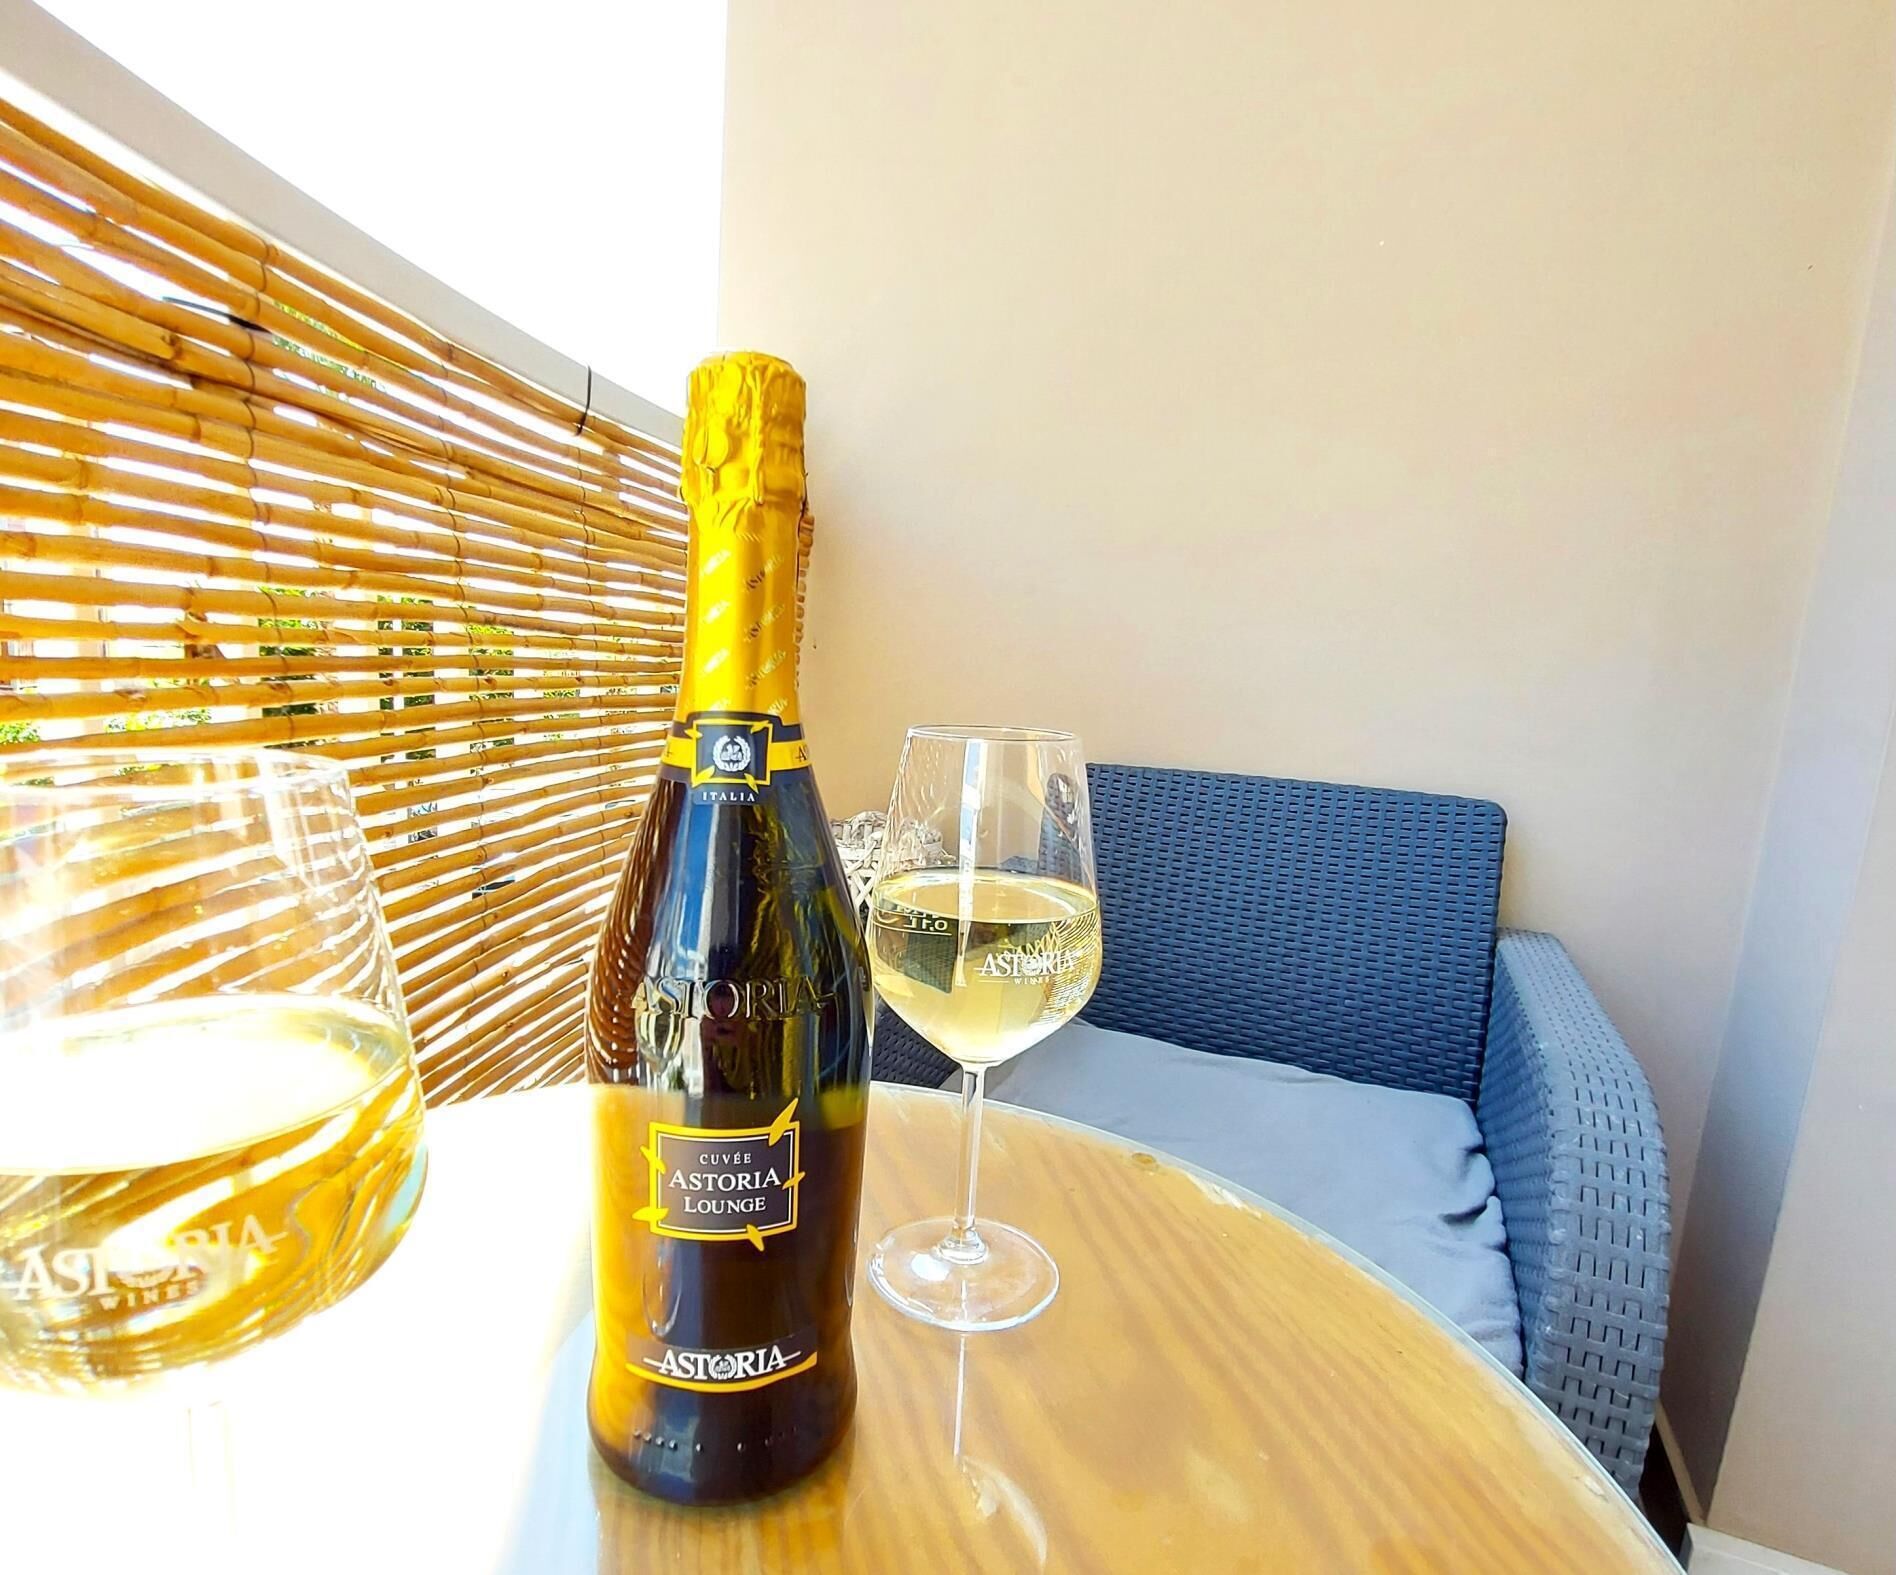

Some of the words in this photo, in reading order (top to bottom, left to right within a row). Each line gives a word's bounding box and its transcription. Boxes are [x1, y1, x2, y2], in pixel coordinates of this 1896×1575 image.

[702, 791, 756, 802] ITALIA
[699, 1151, 752, 1165] CUVÉE
[668, 1167, 782, 1192] ASTORIA
[684, 1196, 767, 1214] LOUNGE
[99, 1279, 201, 1310] WINES
[655, 1345, 790, 1380] ASTORIA
